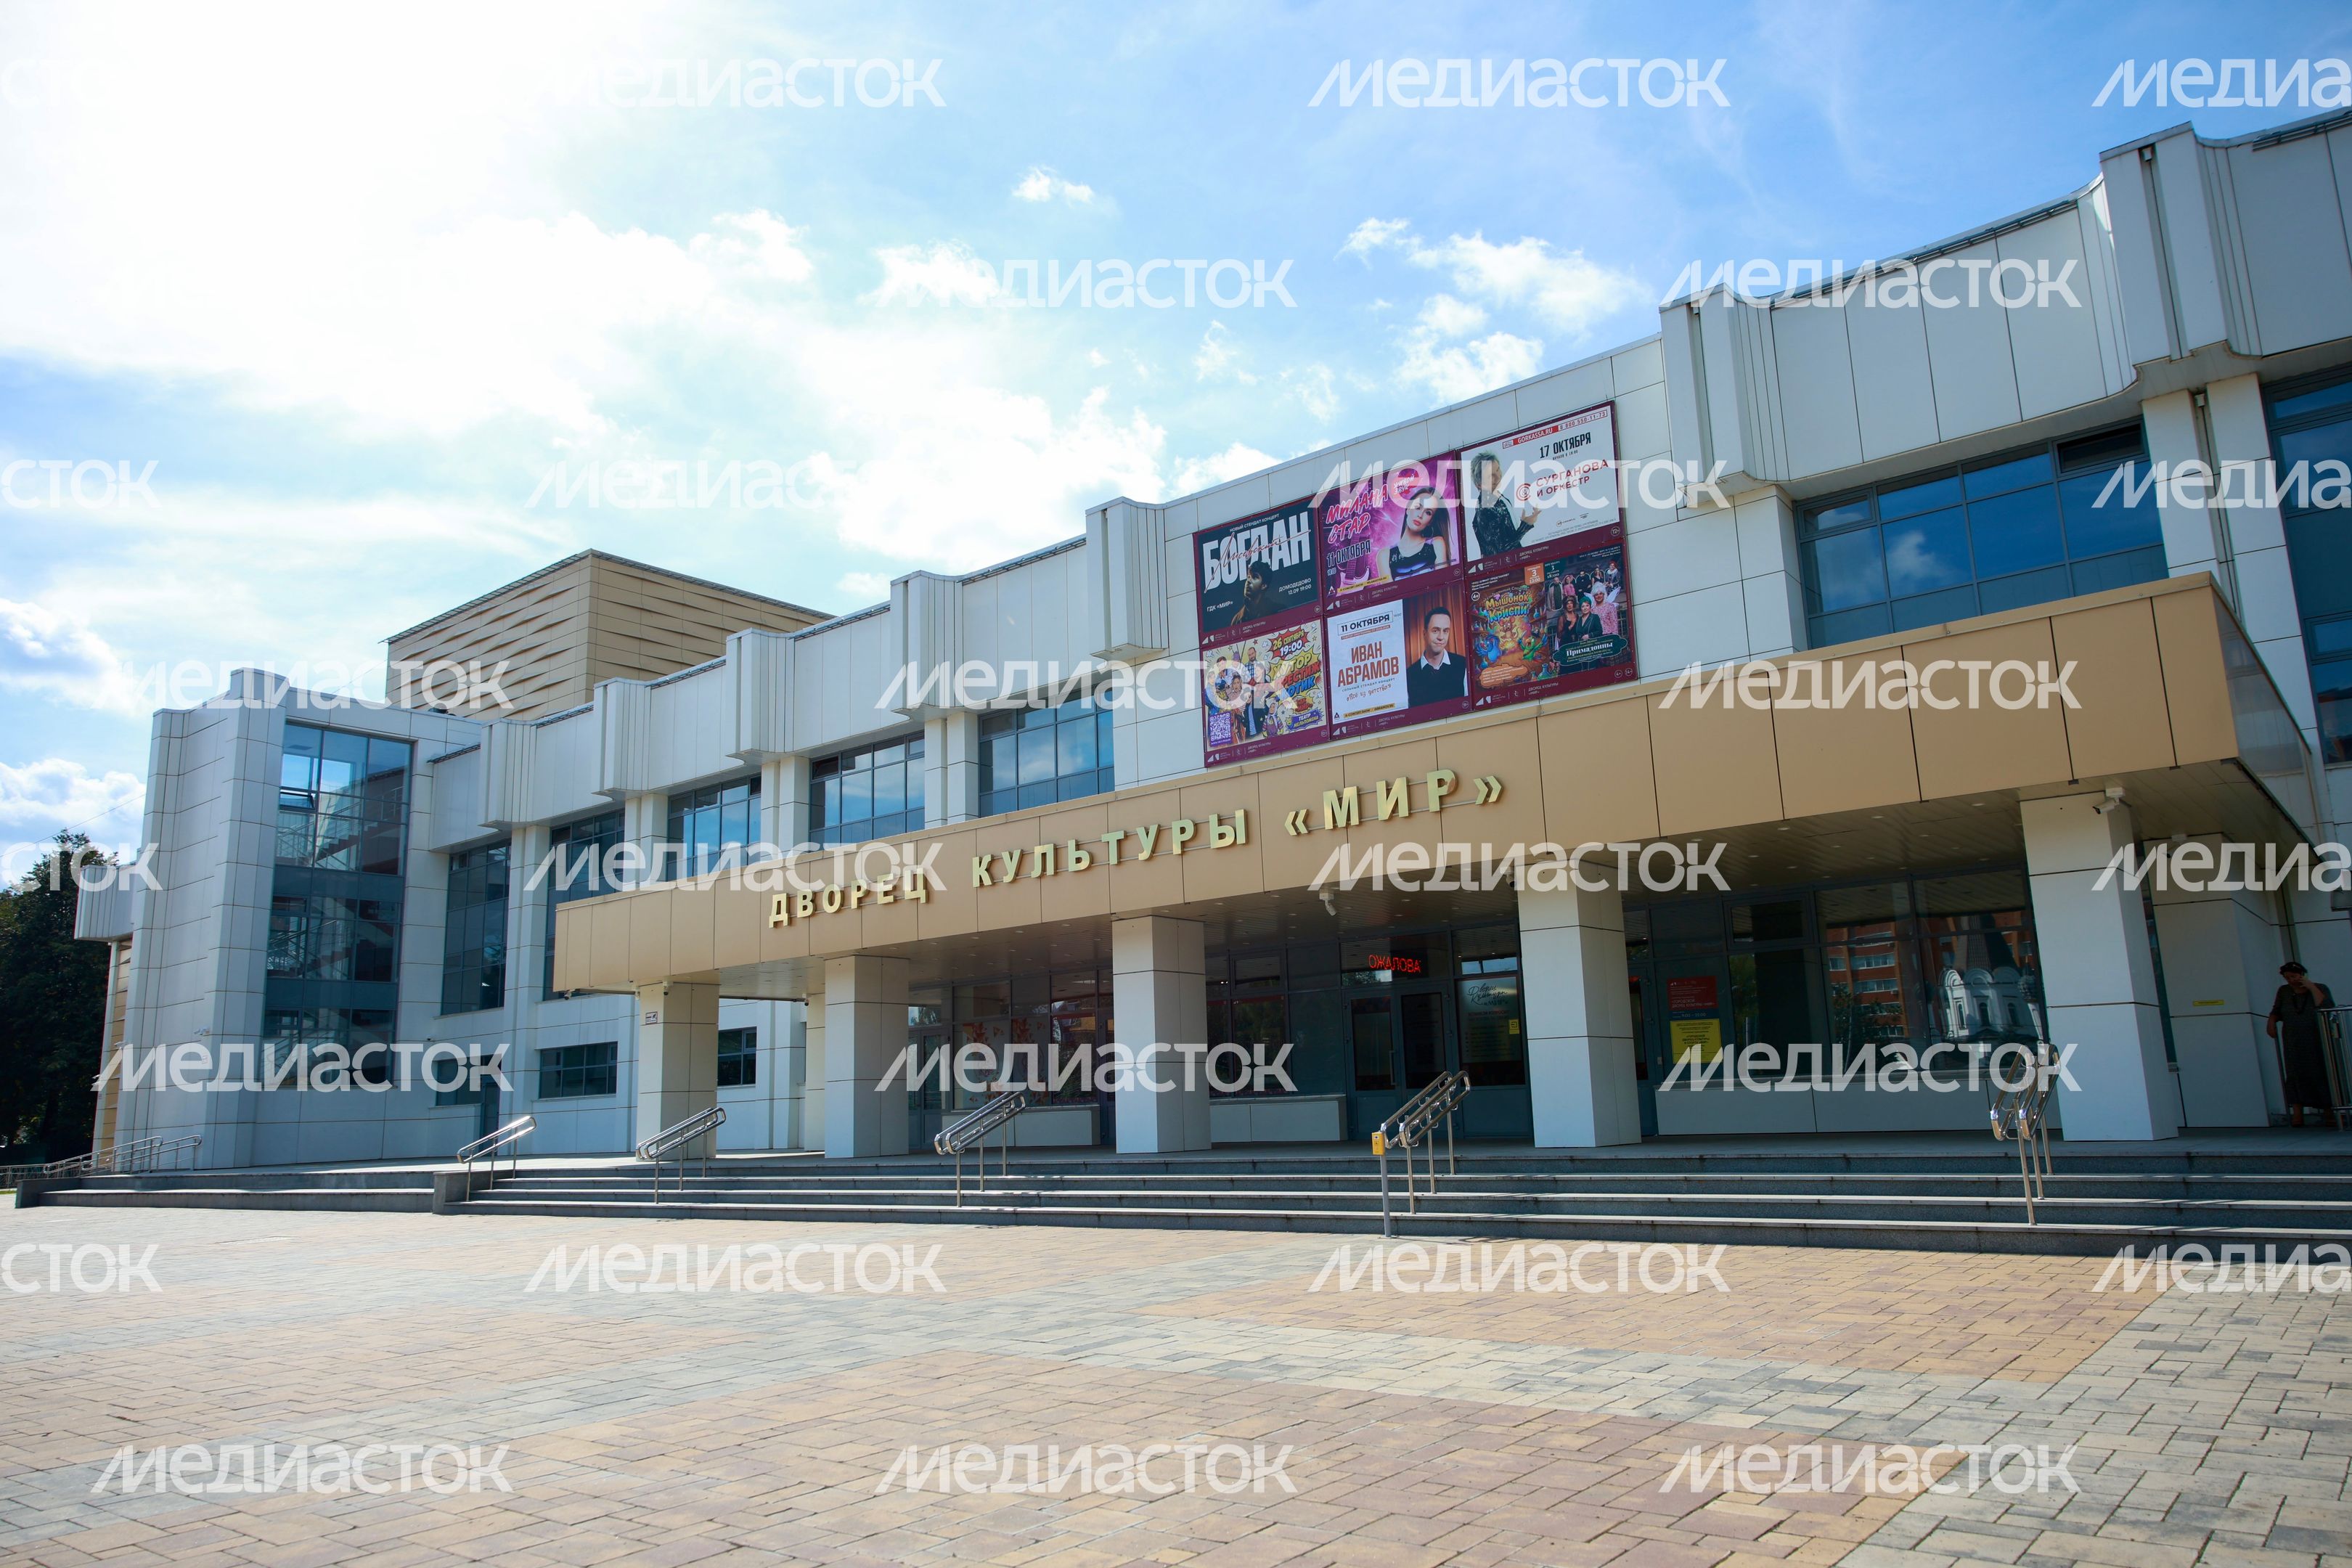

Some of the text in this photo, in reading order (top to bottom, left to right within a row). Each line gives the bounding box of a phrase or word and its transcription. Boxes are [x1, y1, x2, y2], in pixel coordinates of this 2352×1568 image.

[1577, 412, 1606, 424] 550-11-73
[1518, 428, 1553, 444] GORKASSA.RU
[1540, 432, 1591, 459] 17 ОКТЯБРЯ
[1536, 460, 1609, 486] СУРГАНОВА
[1546, 475, 1590, 494] ОРКЕСТР
[1326, 484, 1388, 523] МИЛАНА
[1244, 519, 1261, 528] СТЕНДАП
[1262, 514, 1279, 523] КОНЦЕРТ
[1328, 513, 1371, 543] СТАР
[1203, 511, 1310, 590] БОГДАН
[1327, 539, 1371, 567] 11 ОКТЯБРЯ
[1278, 578, 1311, 592] ДОМОДЕДОВО
[1299, 584, 1311, 592] 19:00
[1350, 614, 1389, 629] ОКТЯБРЯ
[1273, 637, 1282, 651] 26
[1280, 640, 1302, 656] 19:00
[1351, 641, 1382, 664] ИВАН
[1567, 642, 1613, 656] Примадонны
[1273, 653, 1312, 680] ХУТОР
[1338, 657, 1399, 687] АБРАМОВ
[769, 769, 1503, 928] ДВОРЕЦ КУЛЬТУРЫ «МИР»
